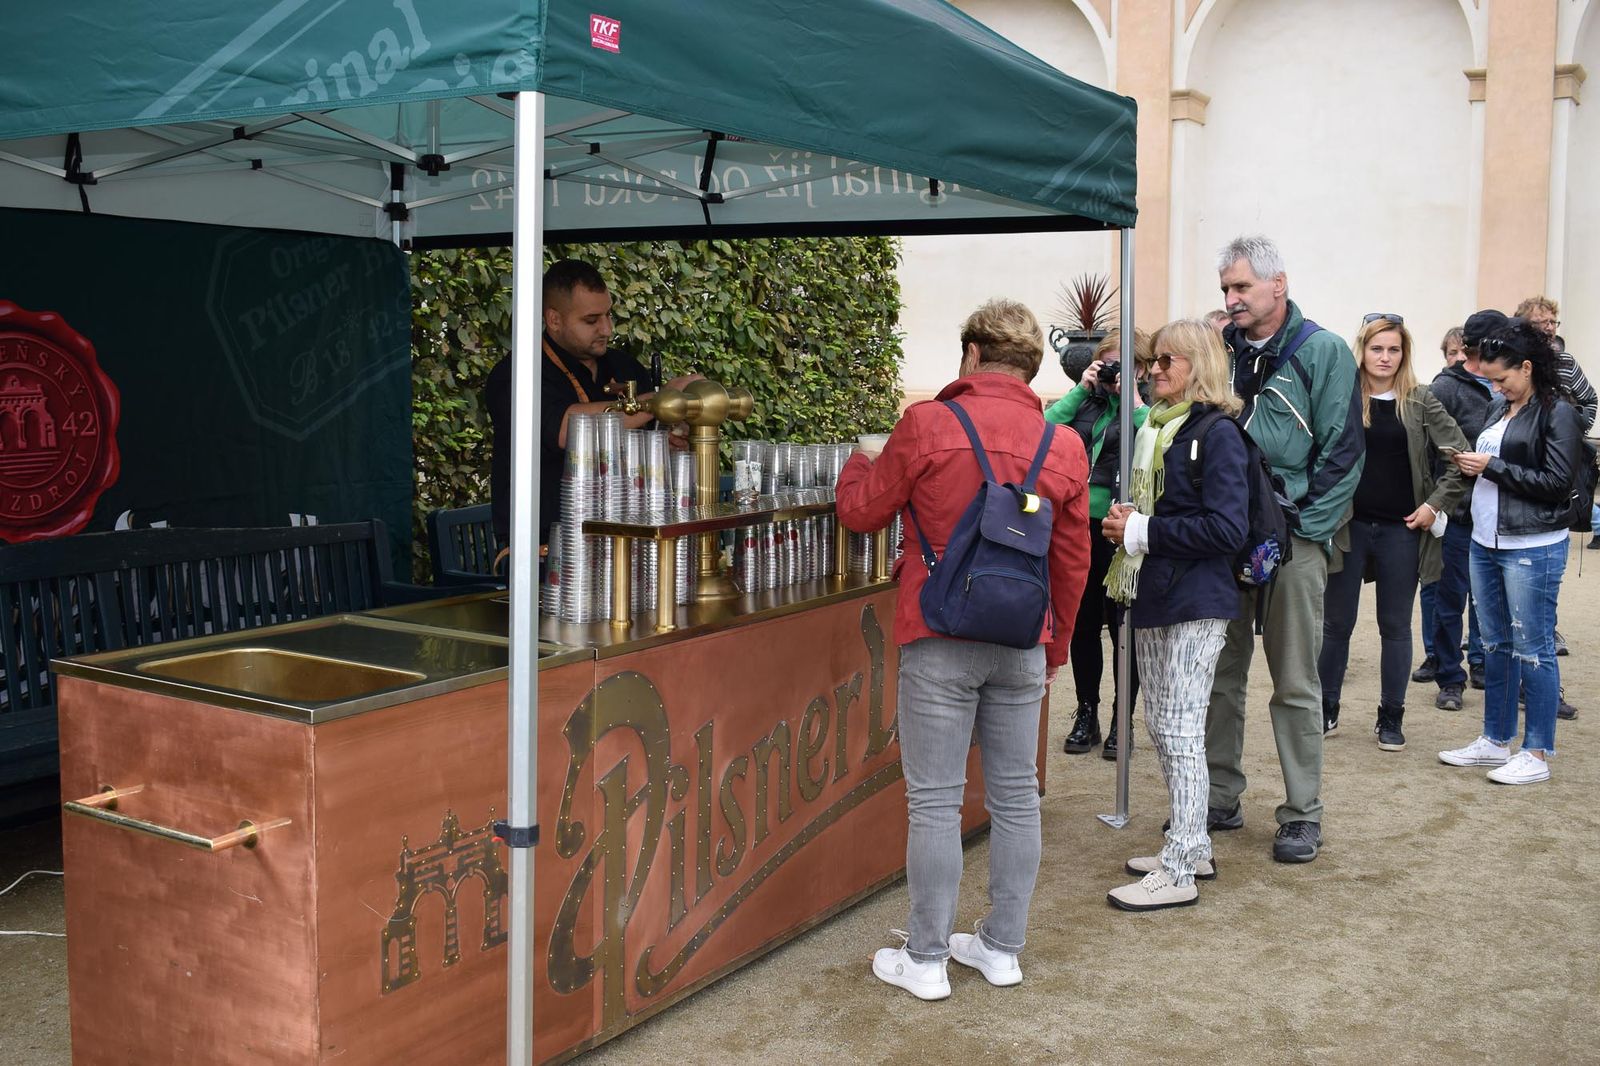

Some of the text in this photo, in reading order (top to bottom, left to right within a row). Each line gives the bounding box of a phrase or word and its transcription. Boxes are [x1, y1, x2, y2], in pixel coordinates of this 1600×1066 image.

[592, 18, 619, 37] TKF
[238, 262, 351, 351] Pilsner
[62, 411, 96, 437] 42
[548, 671, 863, 1020] Pilsner
